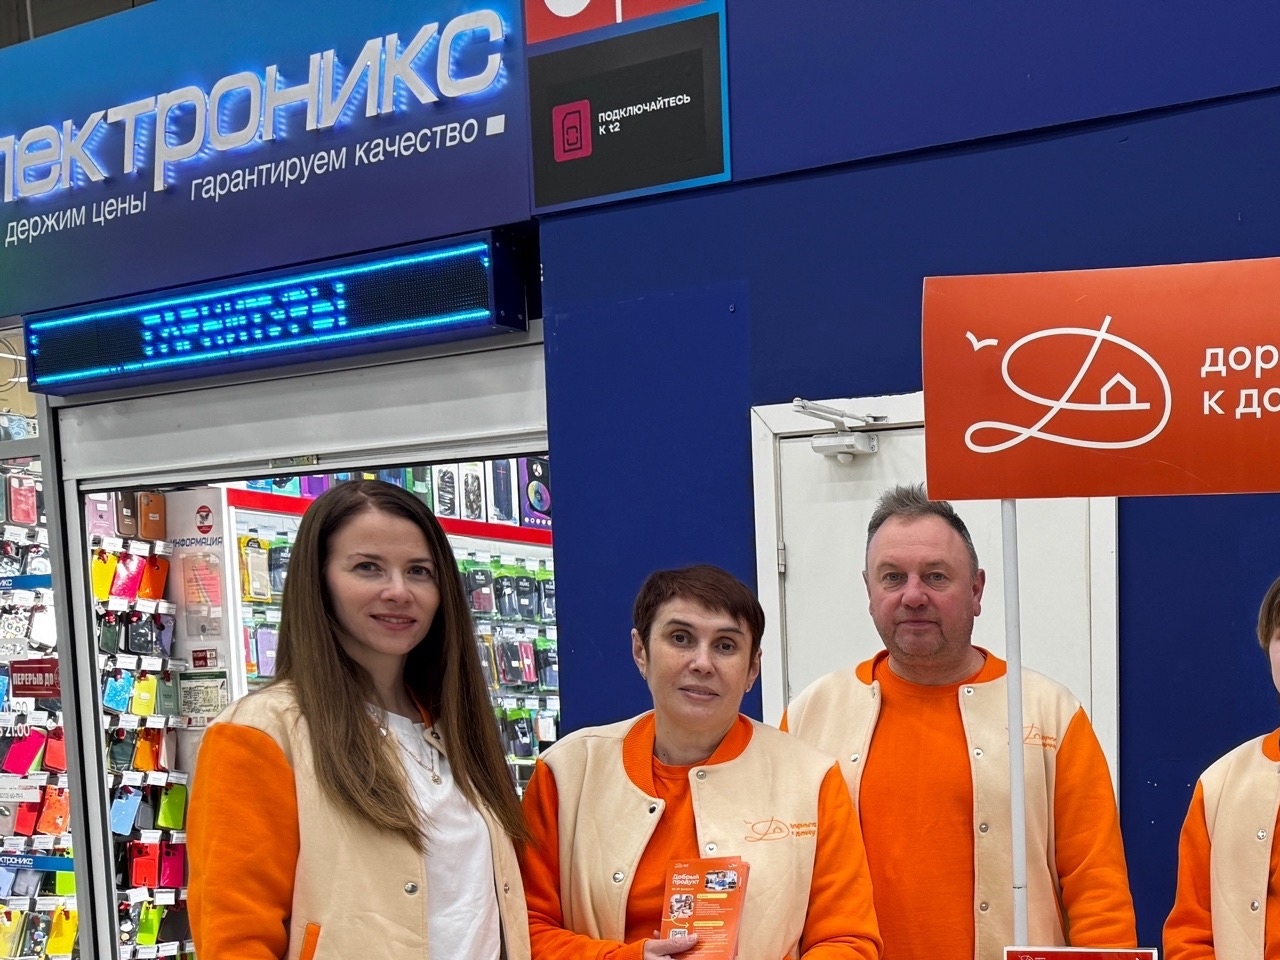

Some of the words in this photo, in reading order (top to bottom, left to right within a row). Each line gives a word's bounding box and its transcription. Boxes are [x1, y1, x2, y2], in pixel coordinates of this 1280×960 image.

[598, 93, 691, 122] ПОДКЛЮЧАЙТЕСЬ
[599, 126, 606, 135] К
[609, 122, 620, 132] t2
[5, 206, 86, 247] держим
[93, 192, 147, 226] цены
[190, 145, 346, 201] гарантируем
[354, 119, 478, 167] качество
[1203, 390, 1225, 414] к
[13, 673, 43, 685] ПЕРЕРЫВ
[45, 672, 54, 685] ДО
